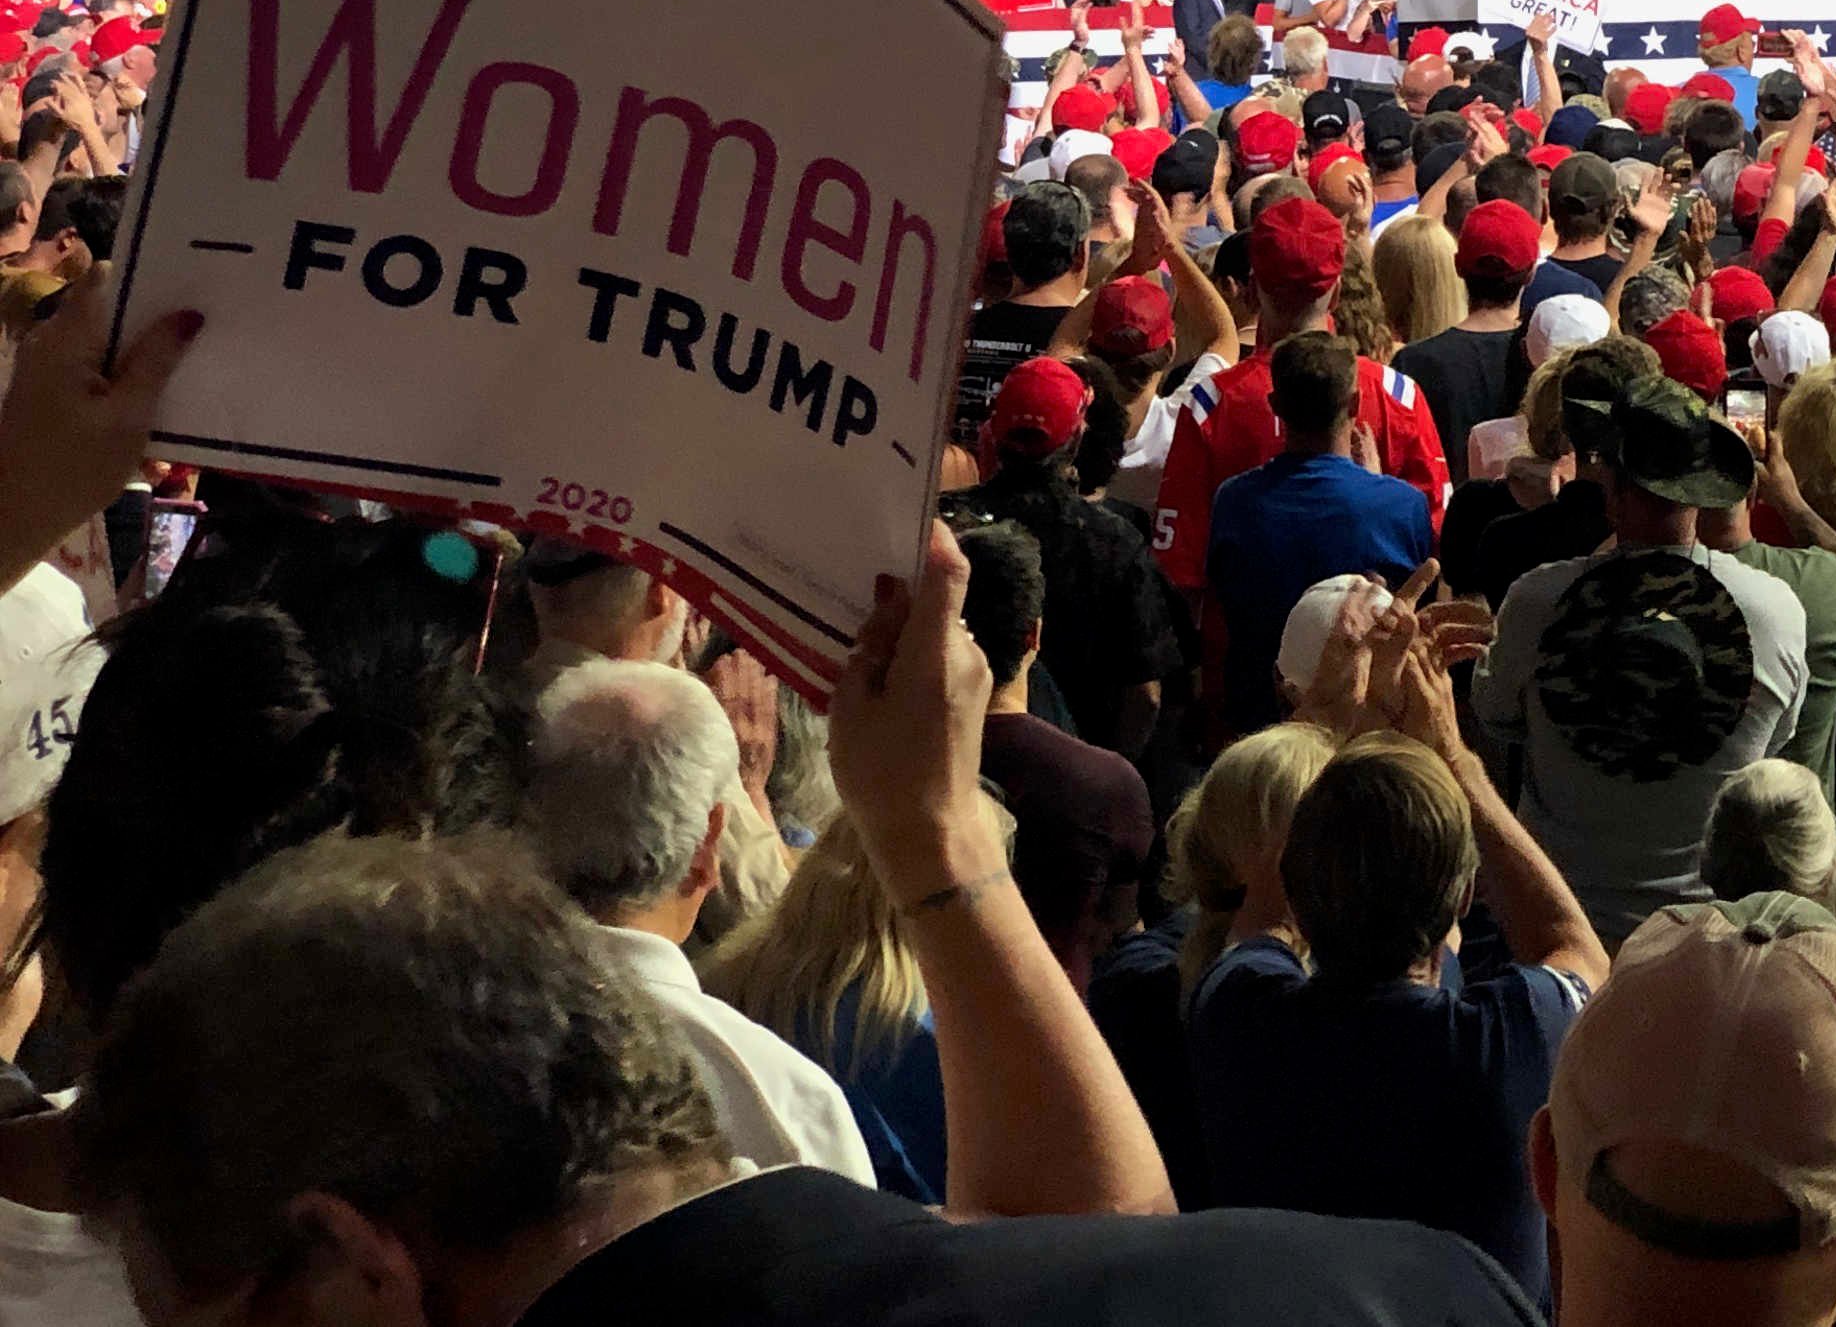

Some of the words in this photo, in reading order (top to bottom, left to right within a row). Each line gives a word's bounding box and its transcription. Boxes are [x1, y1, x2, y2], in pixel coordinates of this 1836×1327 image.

[282, 220, 527, 326] FOR
[578, 268, 878, 449] TRUMP
[534, 477, 634, 525] 2020
[26, 693, 77, 760] 45
